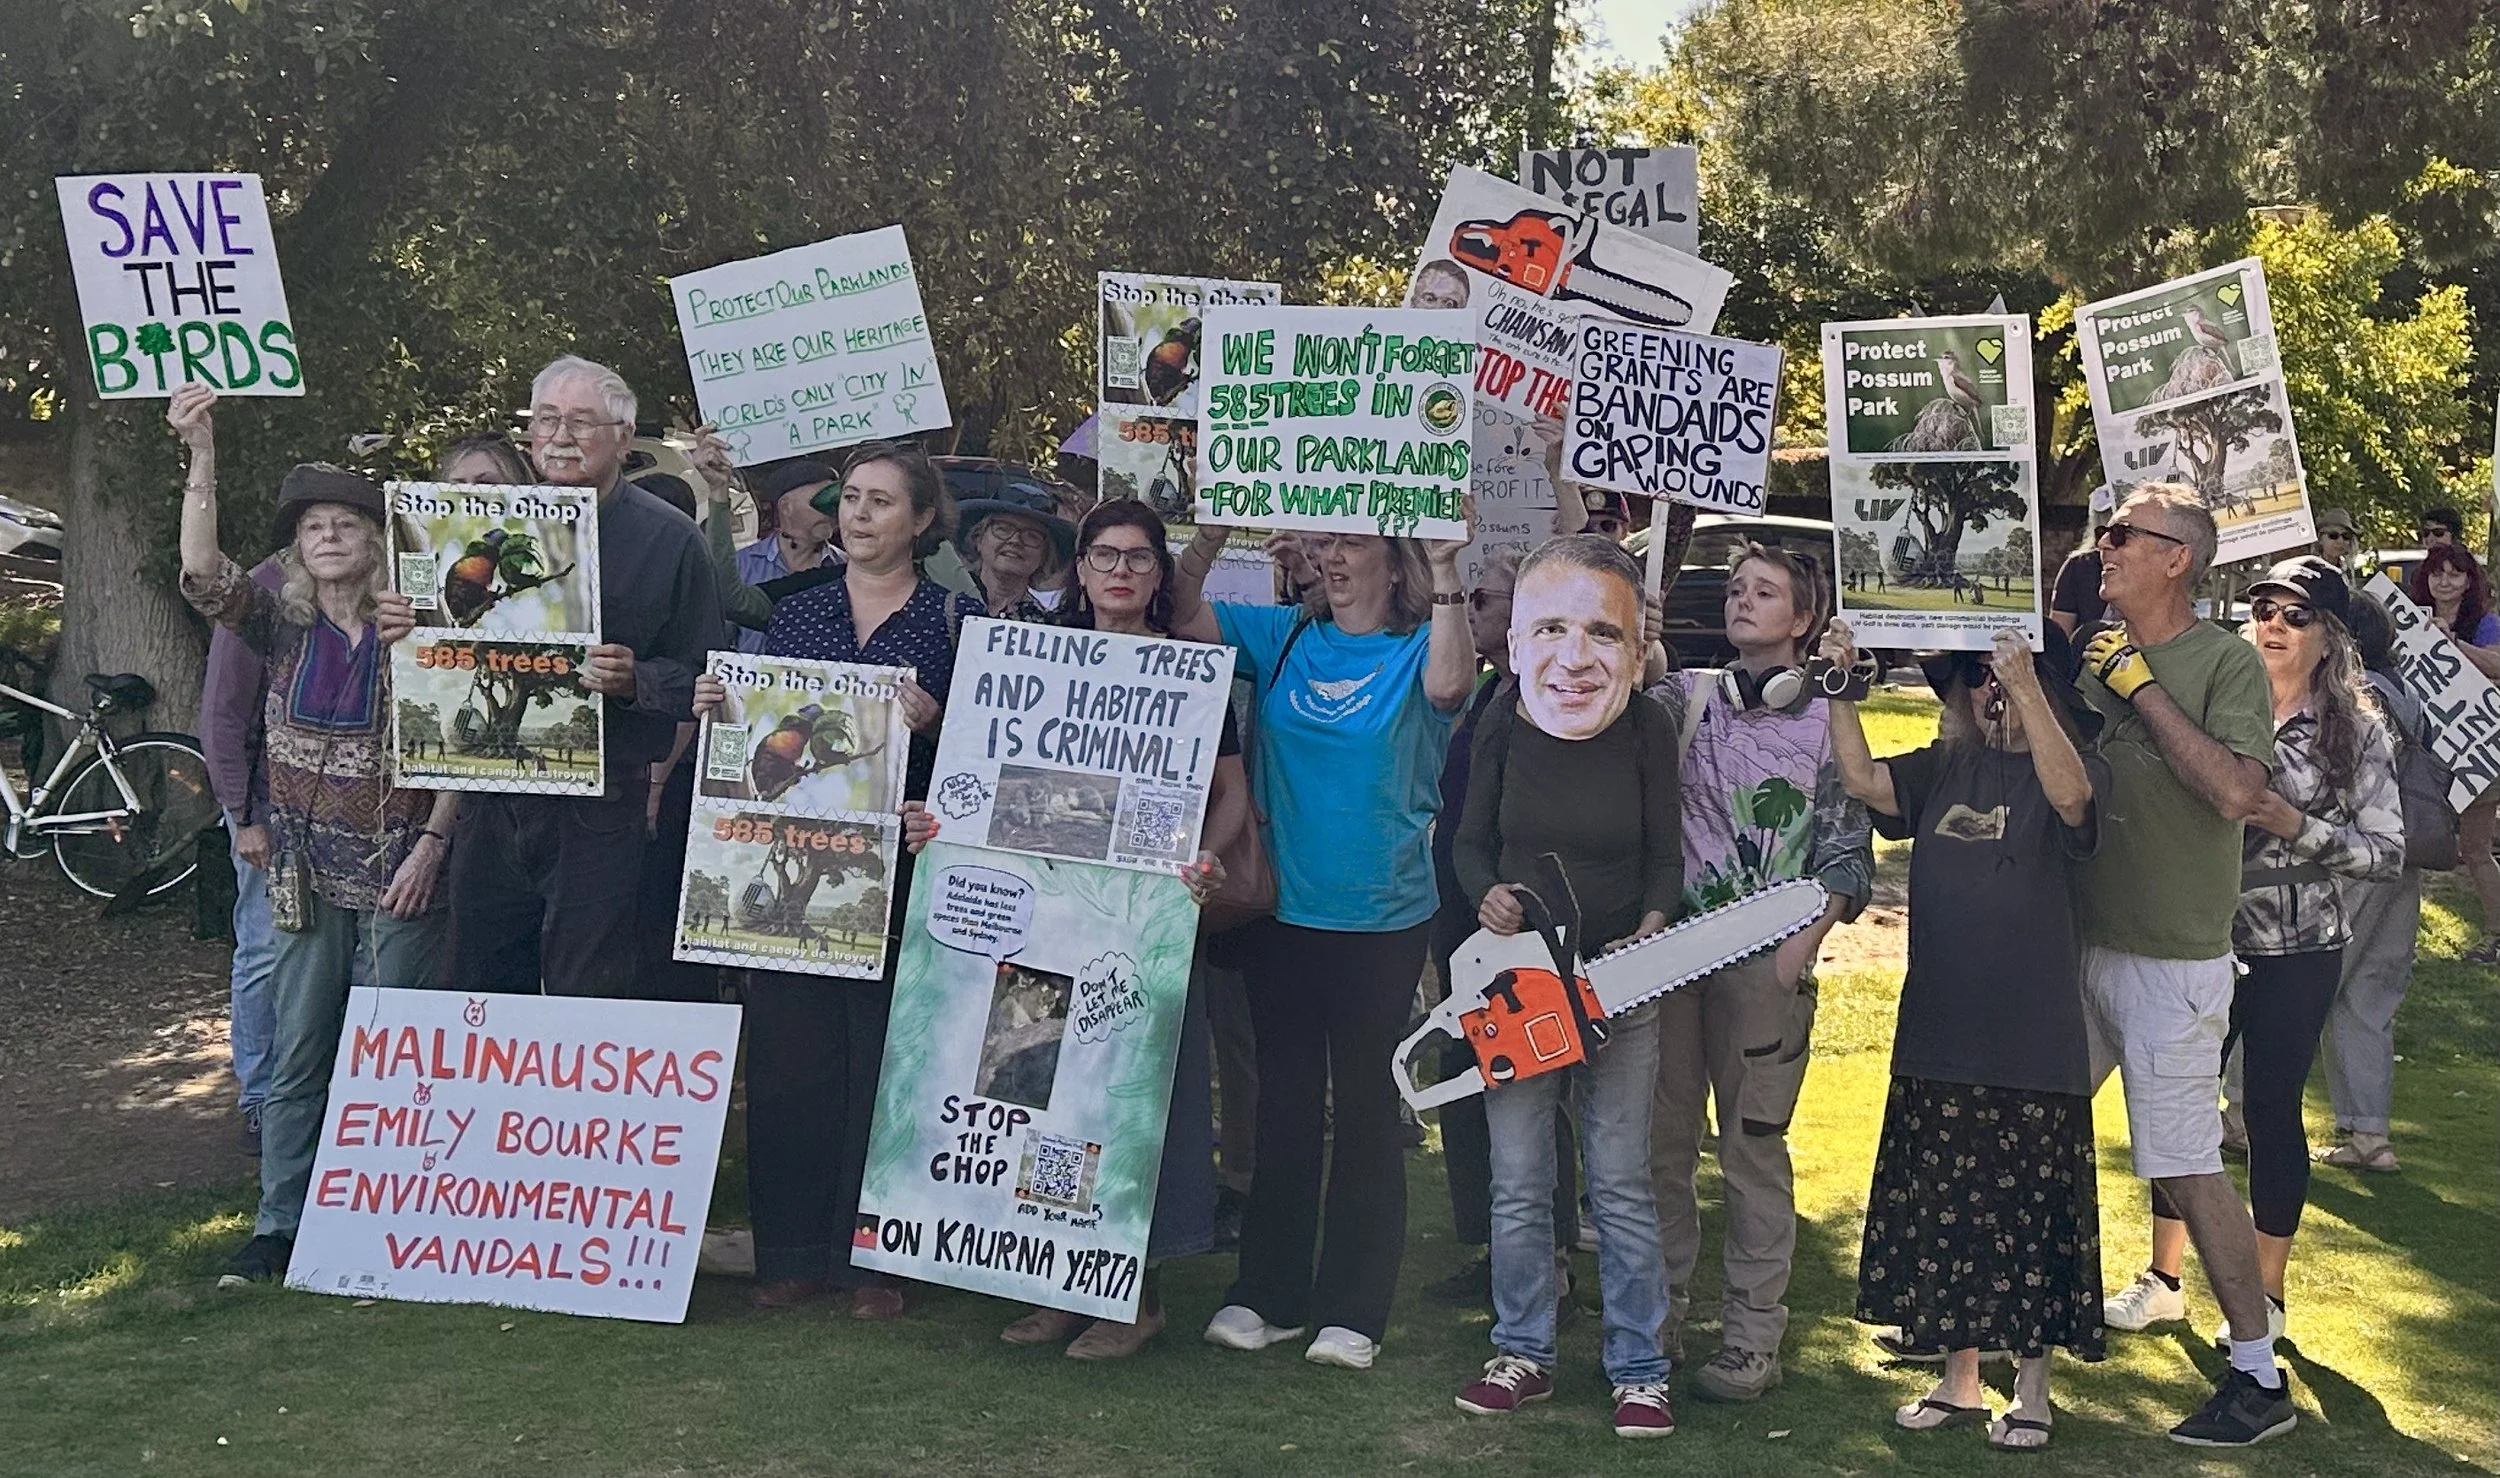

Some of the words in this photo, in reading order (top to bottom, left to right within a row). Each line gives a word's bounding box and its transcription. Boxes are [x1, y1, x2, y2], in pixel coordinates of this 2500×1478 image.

[1532, 149, 1651, 195] NOT
[88, 180, 254, 259] SAVE
[1562, 182, 1687, 227] EGAL
[123, 260, 241, 317] THE
[688, 286, 775, 324] PROTECT
[775, 280, 814, 305] OUR
[815, 262, 910, 297] PARKLANDS
[1105, 282, 1157, 308] Stop
[1162, 288, 1200, 307] the
[1488, 280, 1506, 301] Oh
[1484, 304, 1576, 356] CHAINSAW
[2097, 302, 2173, 335] Protect
[690, 349, 744, 375] THEY
[752, 343, 787, 365] ARE
[792, 331, 837, 360] OUR
[844, 315, 925, 348] HERITAGE
[1222, 329, 1275, 375] WE
[1293, 323, 1381, 378] WON'T
[1383, 335, 1476, 377] FORGET
[1583, 327, 1735, 376] GREENING
[1845, 339, 1927, 361] Protect
[2101, 326, 2182, 359] Possum
[1475, 343, 1526, 402] TOP
[1580, 352, 1702, 395] GRANTS
[1718, 376, 1774, 409] ARE
[1847, 370, 1933, 389] Possum
[2105, 357, 2154, 382] Park
[703, 395, 786, 428] WORLD'S
[791, 382, 836, 407] ONLY
[1575, 382, 1767, 454] BANDAIDS
[1848, 396, 1900, 417] Park
[1119, 420, 1172, 444] 585
[1576, 418, 1614, 441] ON
[1209, 435, 1282, 473] OUR
[1296, 435, 1471, 480] PARKLANDS
[1572, 434, 1723, 481] GAPING
[2124, 441, 2171, 470] LIV
[1280, 482, 1364, 517] WHAT
[1471, 479, 1555, 499] PROFIT
[1635, 465, 1763, 509] WOUNDS
[395, 493, 454, 519] Stop
[461, 498, 505, 517] the
[510, 498, 581, 524] Chop
[1855, 499, 1906, 521] LIV
[416, 646, 477, 670] 585
[486, 649, 571, 675] trees
[987, 625, 1109, 667] FELLING
[1135, 643, 1225, 683] TREES
[715, 664, 774, 691] Stop
[780, 670, 824, 691] the
[831, 674, 896, 703] Chop
[974, 672, 1045, 712] AND
[1066, 680, 1188, 728] HABITAT
[988, 717, 1023, 759] IS
[402, 761, 448, 775] habitat
[450, 764, 476, 776] and
[480, 767, 525, 779] canopy
[530, 767, 594, 781] destroyed
[713, 817, 775, 845] 585
[784, 824, 866, 854] trees
[946, 892, 982, 905] Adelaide
[984, 898, 998, 908] has
[1001, 901, 1016, 912] less
[948, 875, 966, 888] Did
[968, 881, 987, 892] you
[990, 882, 1025, 899] know?
[933, 913, 959, 922] spaces
[947, 903, 968, 913] trees
[970, 908, 985, 917] and
[987, 911, 1011, 922] green
[685, 936, 730, 950] habitat
[735, 940, 757, 951] and
[761, 943, 807, 958] canopy
[811, 948, 875, 963] destroyed
[952, 927, 967, 936] and
[1080, 967, 1117, 997] DON'T
[1086, 991, 1105, 1013] LET
[1111, 979, 1128, 999] ME
[1078, 990, 1144, 1033] DISAPPEAR
[350, 1024, 724, 1102] MALINAUSKAS
[336, 1102, 476, 1160] EMILY
[497, 1110, 684, 1166] BOURKE
[940, 1094, 1031, 1137] STOP
[957, 1132, 998, 1156] THE
[316, 1168, 686, 1236] ENVIRONMENTAL
[1017, 1203, 1038, 1216] ADD
[1043, 1208, 1067, 1222] YOUR
[1070, 1217, 1097, 1230] NAME
[386, 1232, 671, 1291] VANDALS!!!
[881, 1218, 923, 1257] ON
[934, 1217, 1054, 1280] KAURNA
[1063, 1248, 1138, 1302] YERTA
